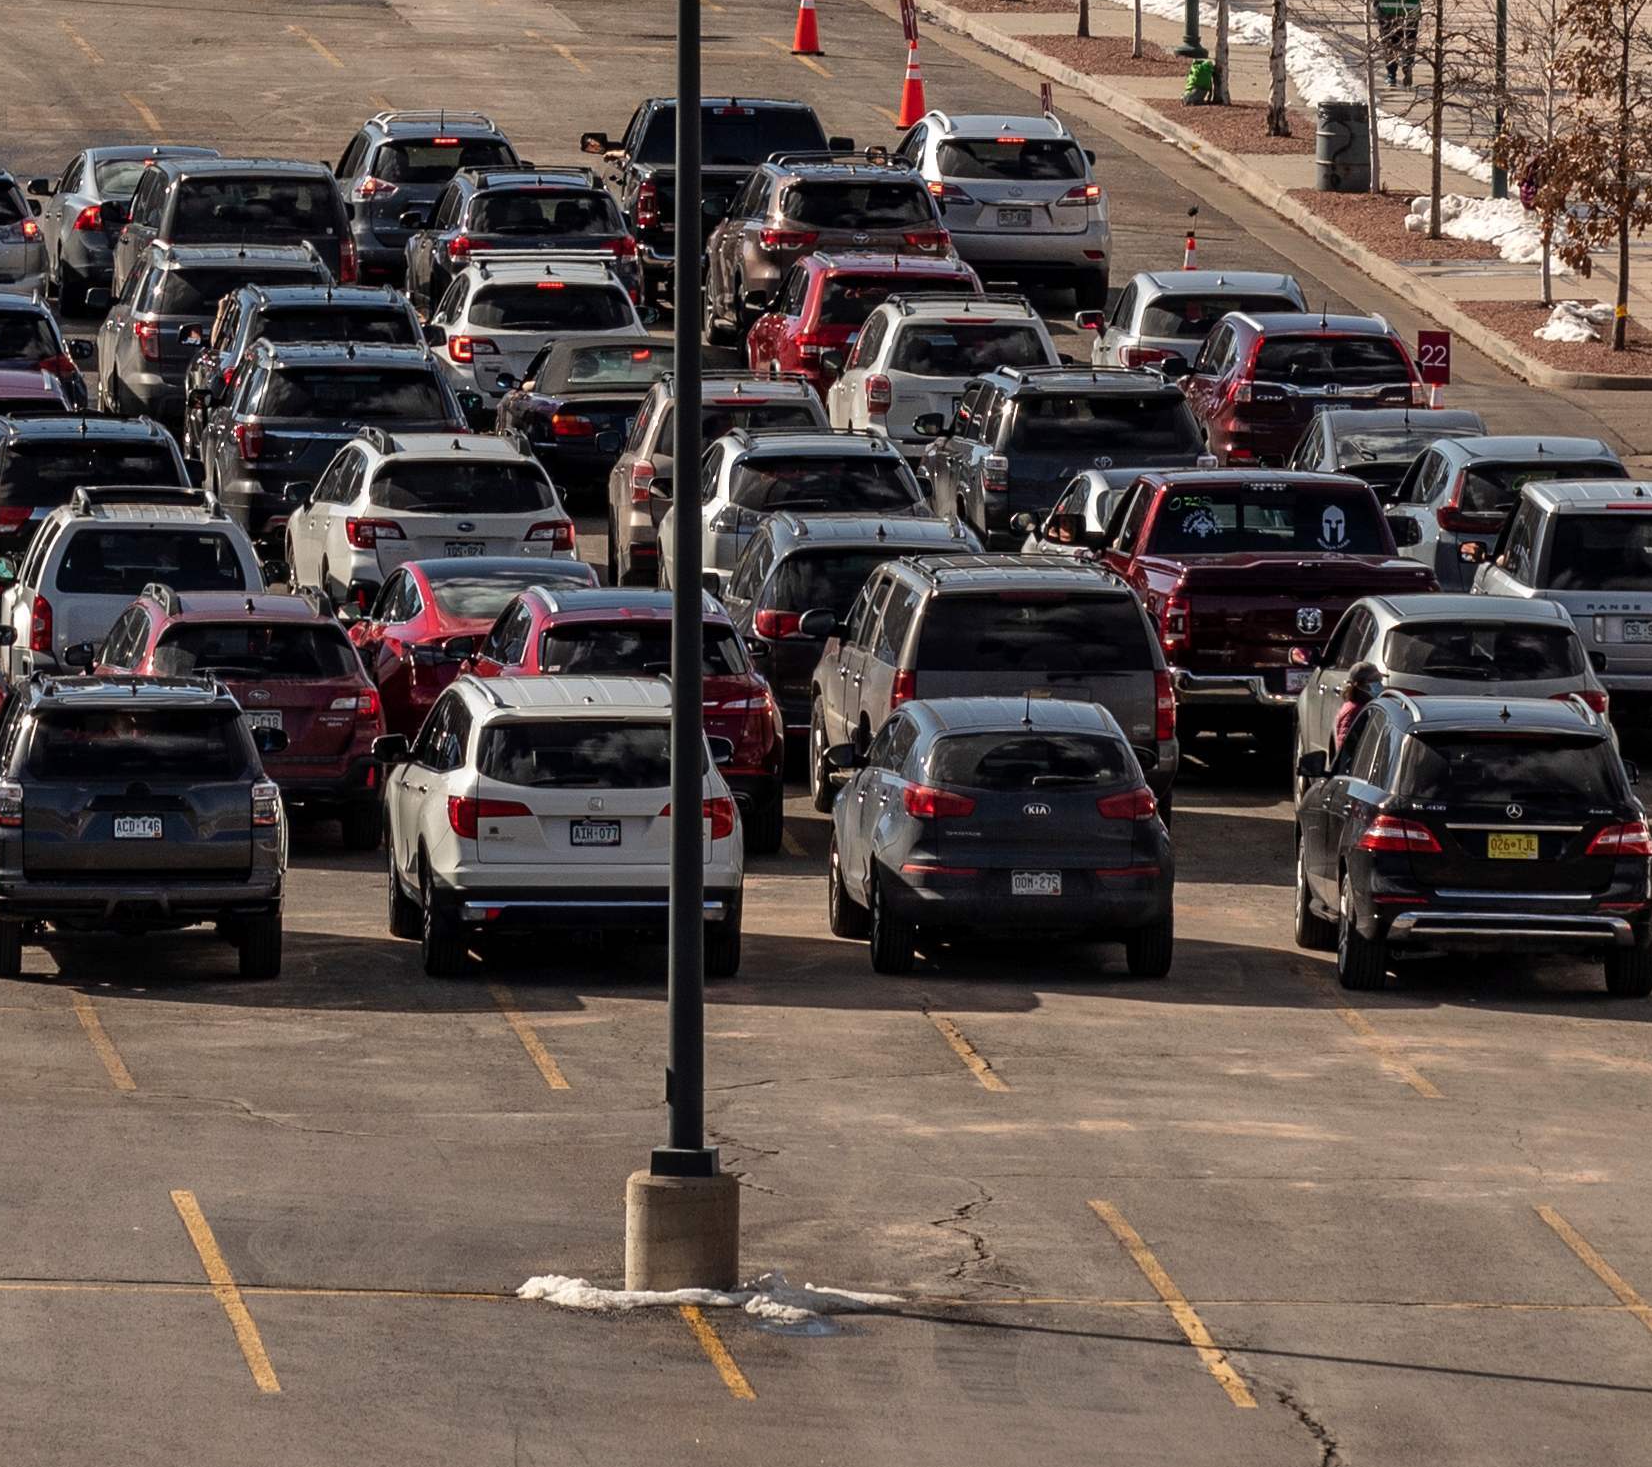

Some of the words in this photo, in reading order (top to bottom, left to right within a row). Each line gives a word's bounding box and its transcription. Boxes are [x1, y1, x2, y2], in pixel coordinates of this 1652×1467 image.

[1421, 344, 1447, 367] 22
[1586, 603, 1642, 611] RANGE
[1028, 806, 1047, 815] KIA
